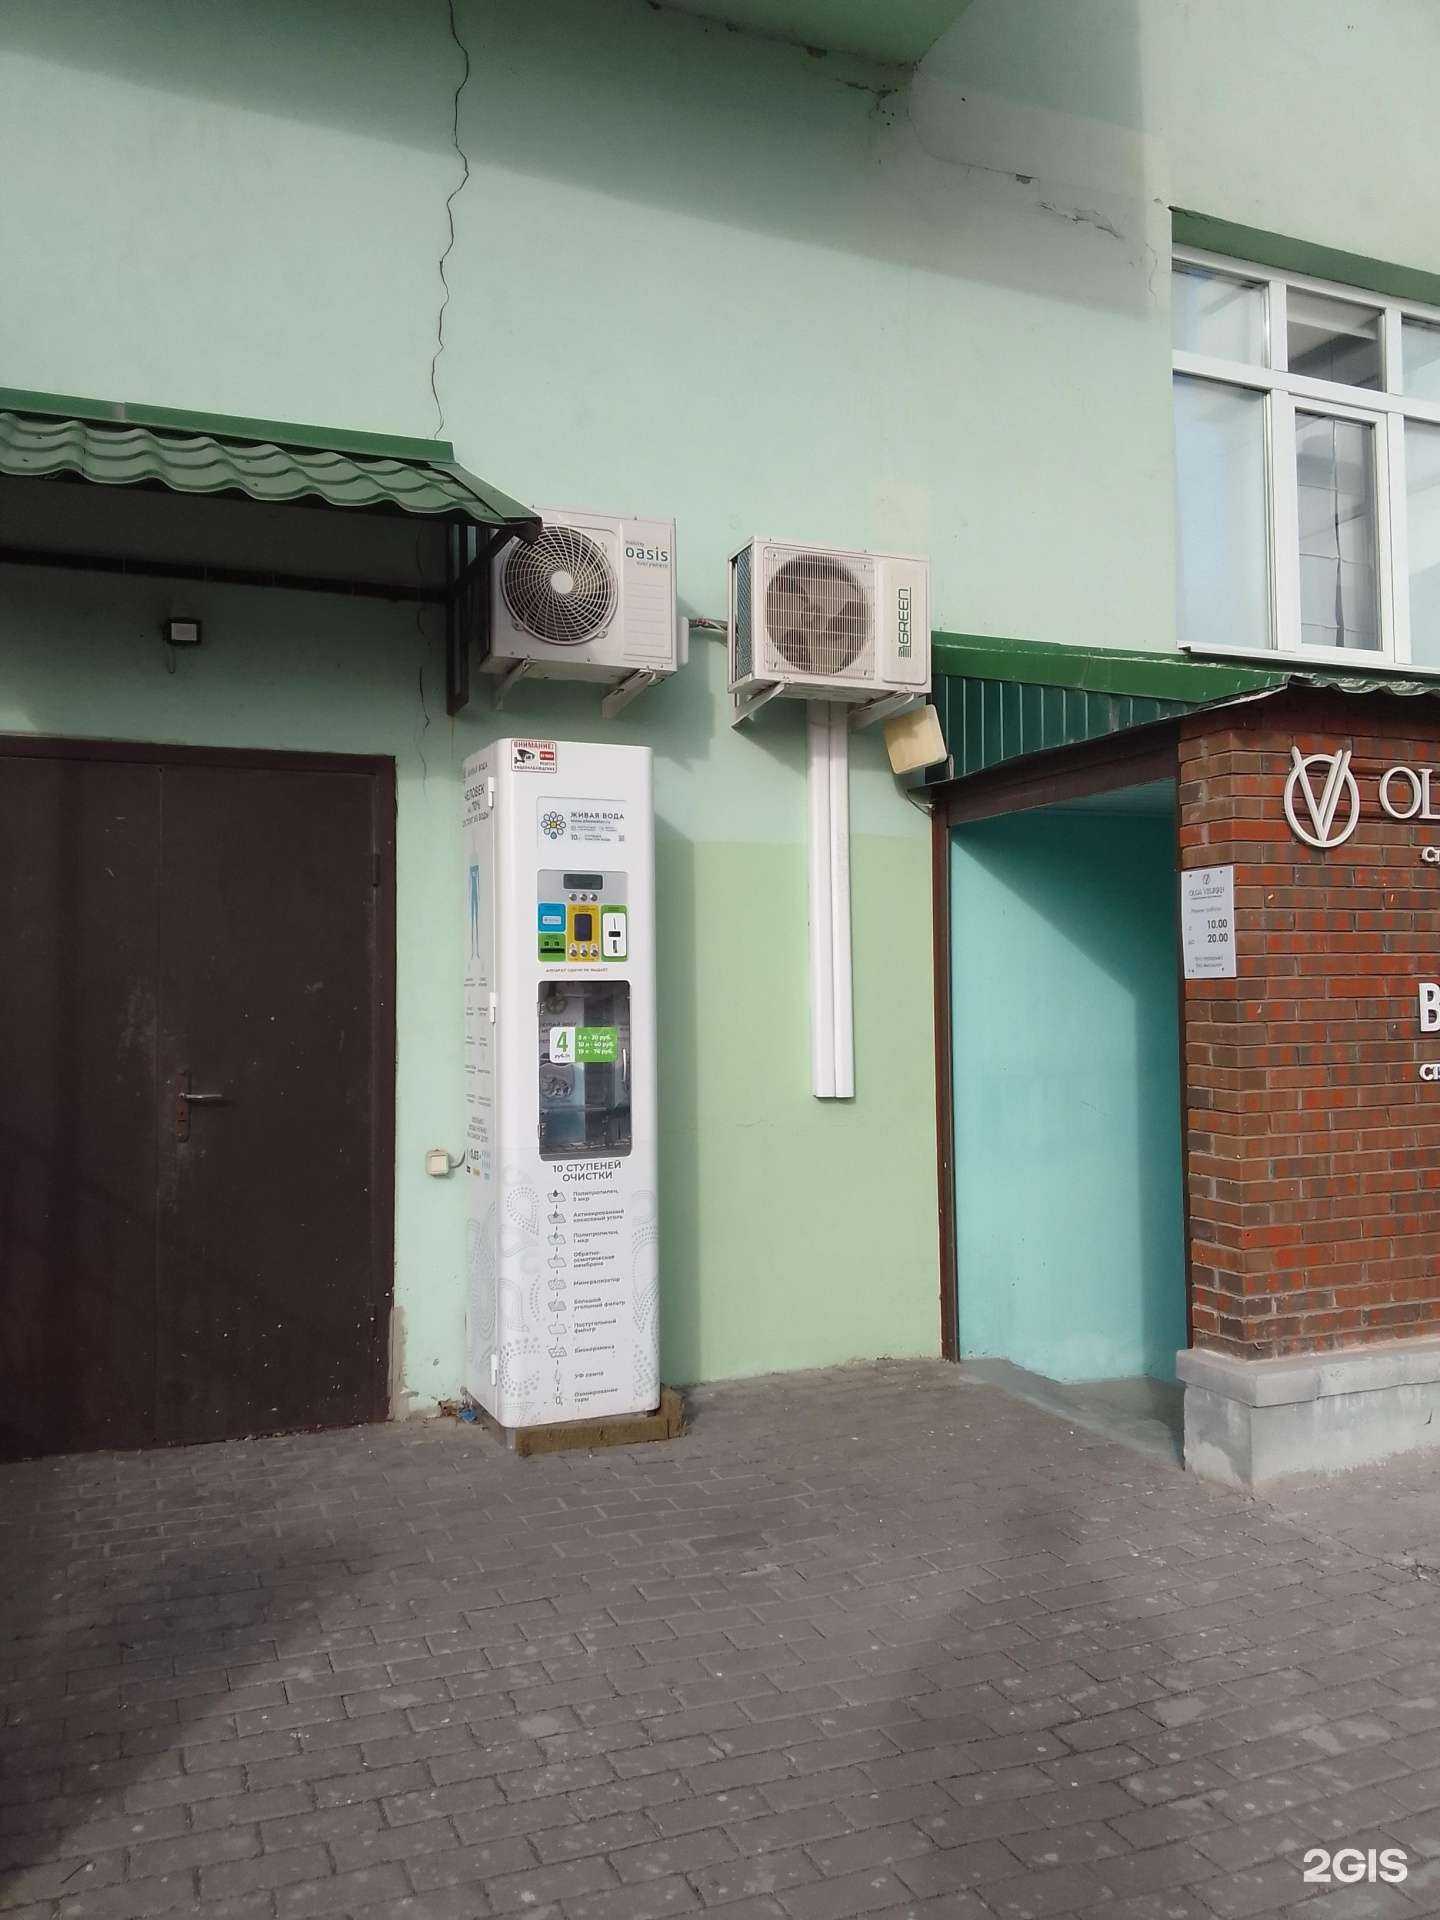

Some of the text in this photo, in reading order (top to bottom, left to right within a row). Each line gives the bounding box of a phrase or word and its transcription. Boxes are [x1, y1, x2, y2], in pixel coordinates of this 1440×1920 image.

[625, 546, 669, 562] oasis
[898, 588, 909, 645] GREEN
[1207, 919, 1228, 929] 10.00
[1207, 933, 1229, 943] 20.00
[556, 1031, 569, 1054] 4
[553, 1160, 622, 1173] 10 СТУПЕНЕЙ
[562, 1171, 613, 1182] ОЧИСТКИ
